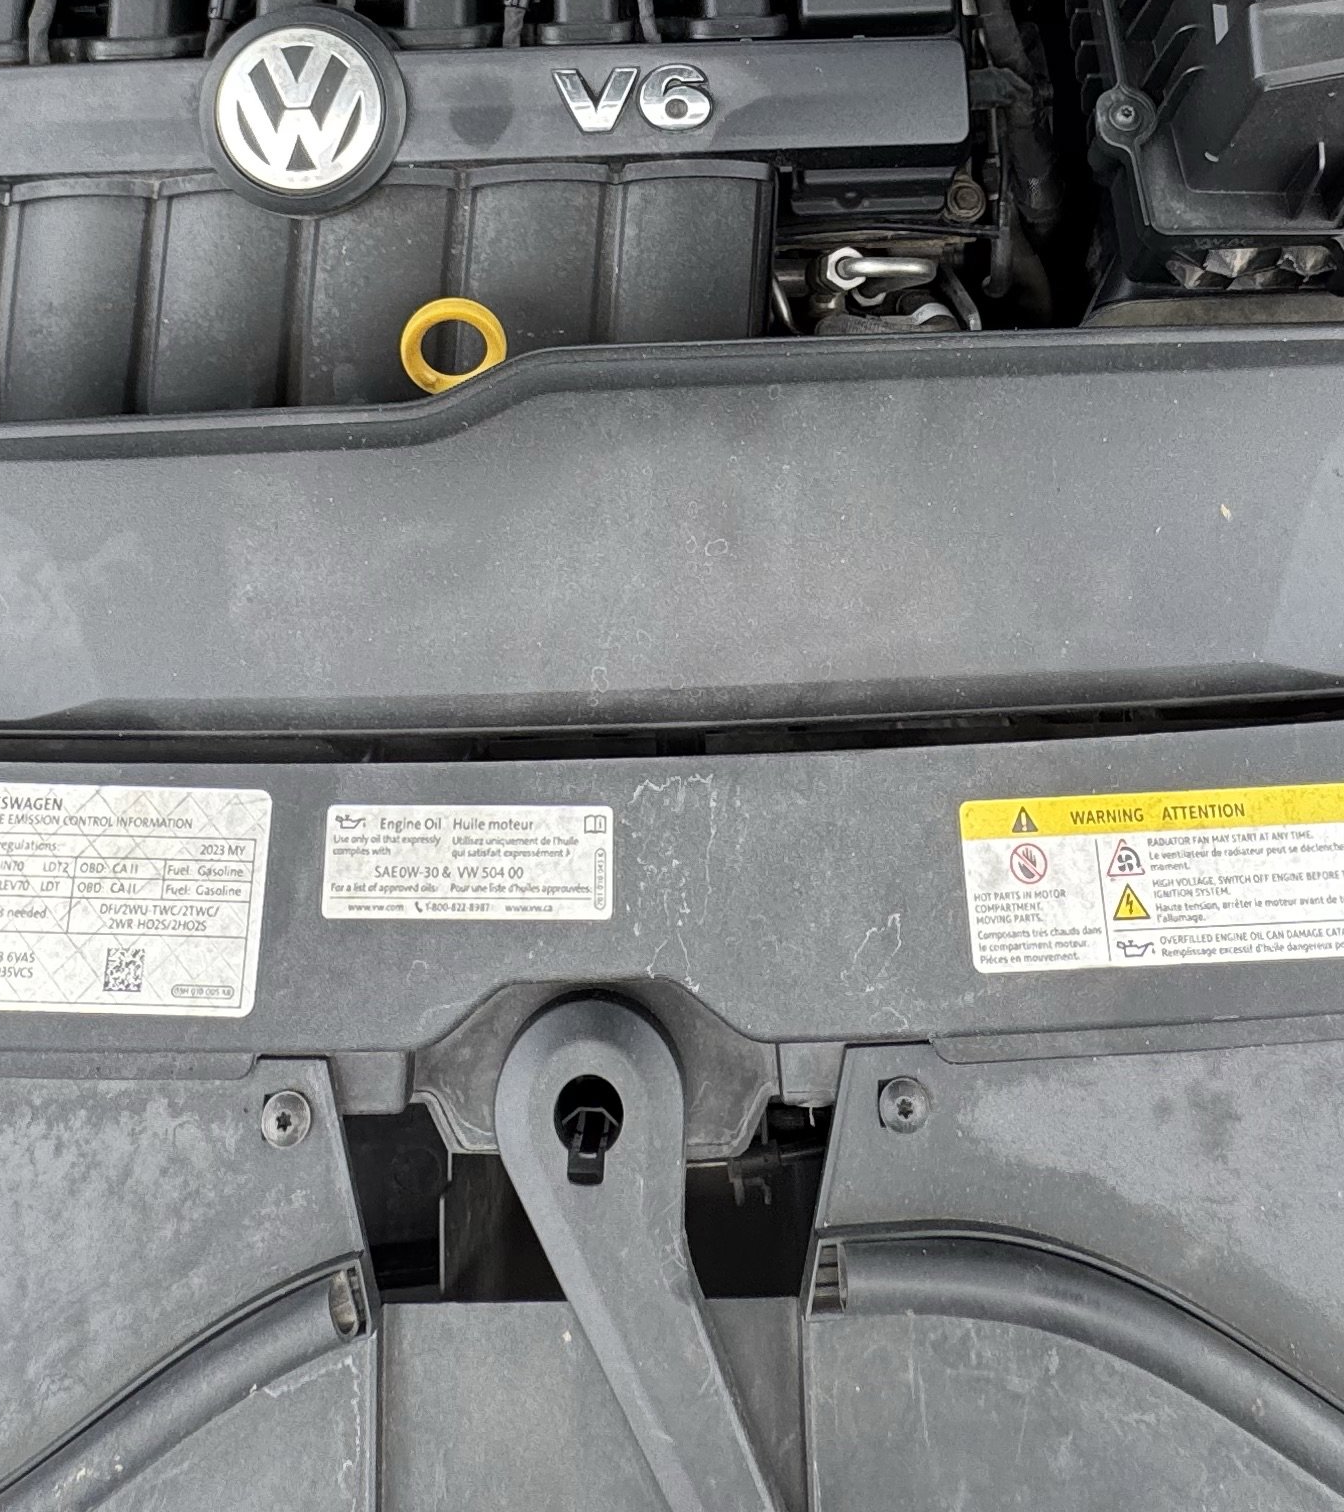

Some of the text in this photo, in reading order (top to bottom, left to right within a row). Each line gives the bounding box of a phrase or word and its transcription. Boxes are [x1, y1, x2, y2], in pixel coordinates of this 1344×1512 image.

[552, 63, 714, 135] V6
[1070, 803, 1245, 825] WARNING ATTENTION
[8, 813, 60, 825] EMISSION
[63, 815, 113, 827] CONTROL
[116, 816, 193, 829] INFORMATION
[380, 817, 442, 834] Engine Oil
[453, 818, 534, 830] Huile moteur
[333, 834, 441, 847] Use only that expressly
[452, 836, 579, 848] Utilisez uniquement de l'huile
[1147, 831, 1288, 846] RADIATOR FAN MAY START ANY
[200, 844, 246, 855] 2023 MY
[333, 847, 391, 857] complies with
[451, 848, 564, 860] qui satisfait expressément
[1161, 849, 1209, 859] ventilateur
[1224, 847, 1263, 856] radiateur
[1266, 846, 1287, 856] peut
[43, 861, 69, 873] LDT2
[113, 863, 127, 873] CA
[198, 865, 244, 877] Gasoline
[442, 865, 452, 879] &
[457, 866, 479, 879] VW
[481, 866, 505, 879] 504
[508, 866, 524, 879] 00
[1152, 879, 1174, 888] HIGH
[1218, 875, 1251, 885] SWITCH
[1253, 874, 1269, 883] OFF
[1272, 872, 1304, 882] ENGINE
[1306, 870, 1340, 881] BEFORE
[40, 881, 60, 891] LDT
[196, 885, 242, 897] Gasoline
[331, 883, 419, 894] For list approved
[450, 883, 469, 893] Pour
[471, 884, 487, 893] une
[489, 883, 506, 893] liste
[508, 883, 540, 893] d'huiles
[974, 889, 1066, 902] HOT PARTS MOTOR
[1153, 889, 1193, 899] IGNITION
[348, 904, 404, 912] www.vw.com
[505, 904, 553, 912] www.vw.ca
[1155, 903, 1182, 912] Haute
[1222, 898, 1252, 909] arrêter
[1264, 898, 1297, 907] moteur
[1299, 896, 1324, 906] avant
[1326, 894, 1337, 904] de
[977, 915, 1012, 925] MOVING
[978, 926, 1102, 940] Composants chauds dans
[1159, 928, 1323, 945] OVERFILLED ENGINE OIL CAN DAMAGE
[990, 941, 1052, 953] compartiment
[1161, 947, 1216, 958] Remplissage
[1219, 944, 1253, 955] excessif
[1286, 941, 1333, 953] dangereux
[980, 954, 1021, 964] Pièces en
